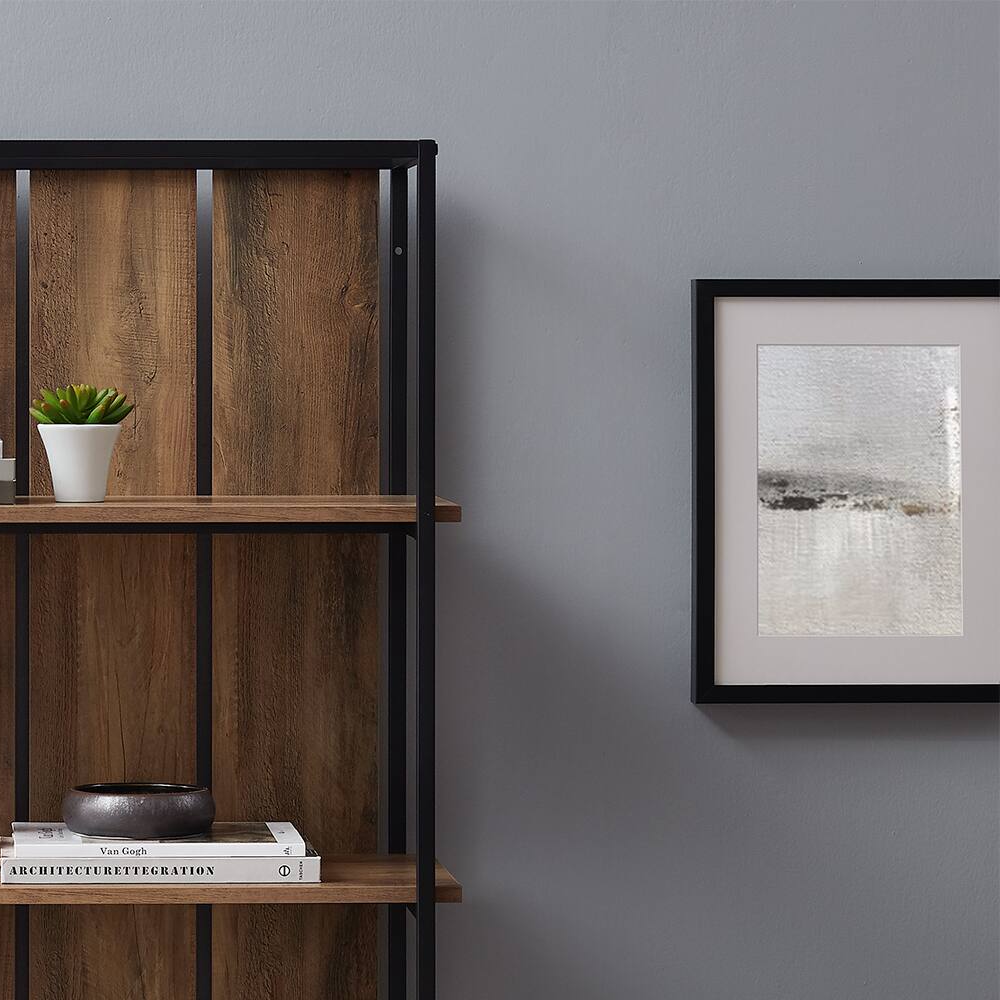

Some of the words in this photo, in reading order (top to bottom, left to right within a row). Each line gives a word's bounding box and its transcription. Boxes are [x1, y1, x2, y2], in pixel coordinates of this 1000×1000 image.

[100, 847, 119, 855] Van
[121, 847, 147, 857] Gogh
[9, 865, 216, 876] ARCHITECTURETTEGRATION
